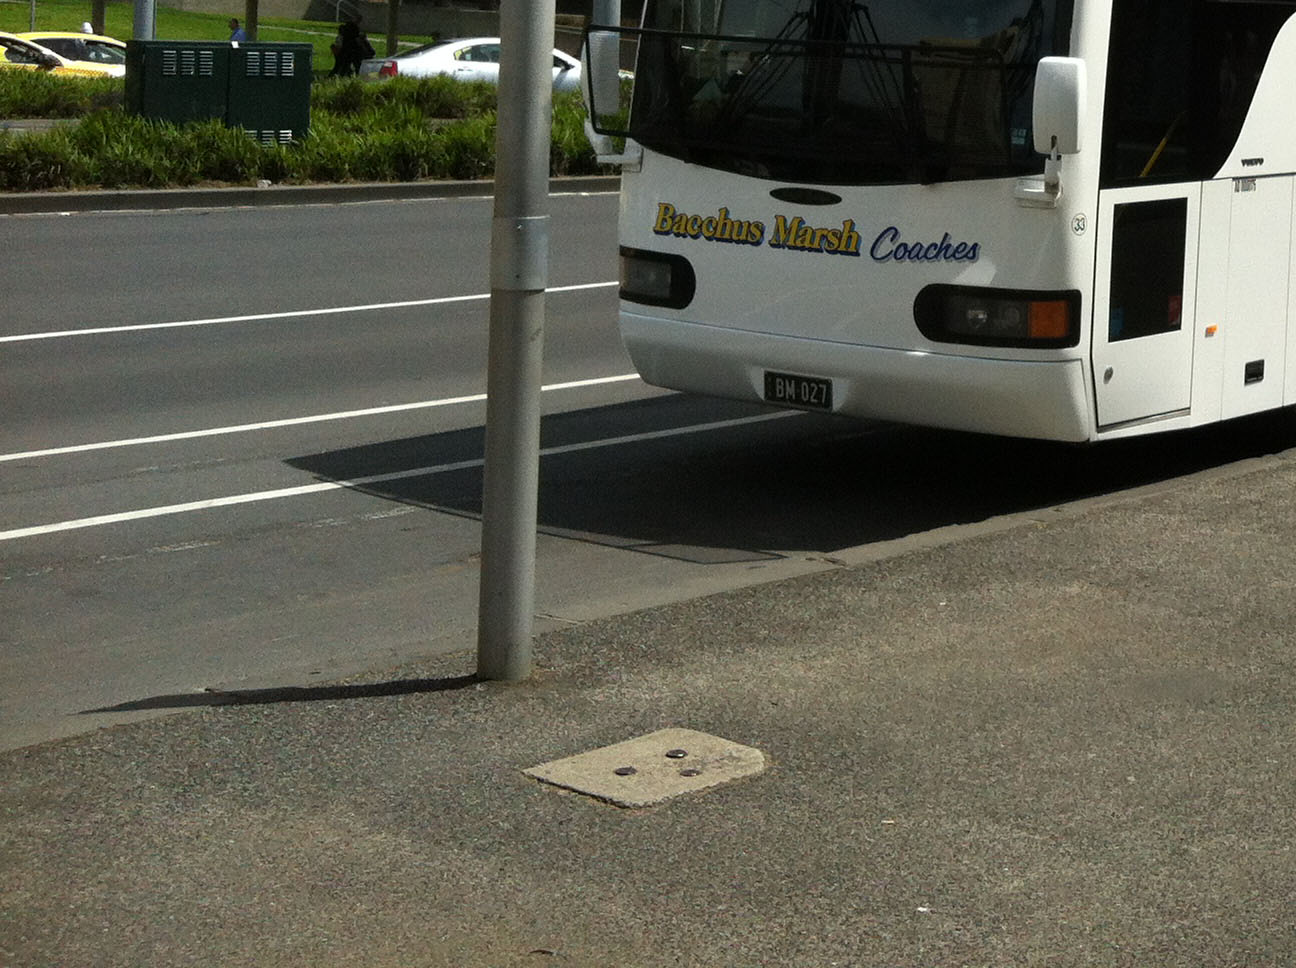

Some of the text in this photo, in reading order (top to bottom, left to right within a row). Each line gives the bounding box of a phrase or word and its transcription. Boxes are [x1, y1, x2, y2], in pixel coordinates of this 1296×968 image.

[653, 202, 981, 263] Bacchus Marsh Coaches
[775, 377, 796, 400] BM
[800, 381, 827, 404] 027
